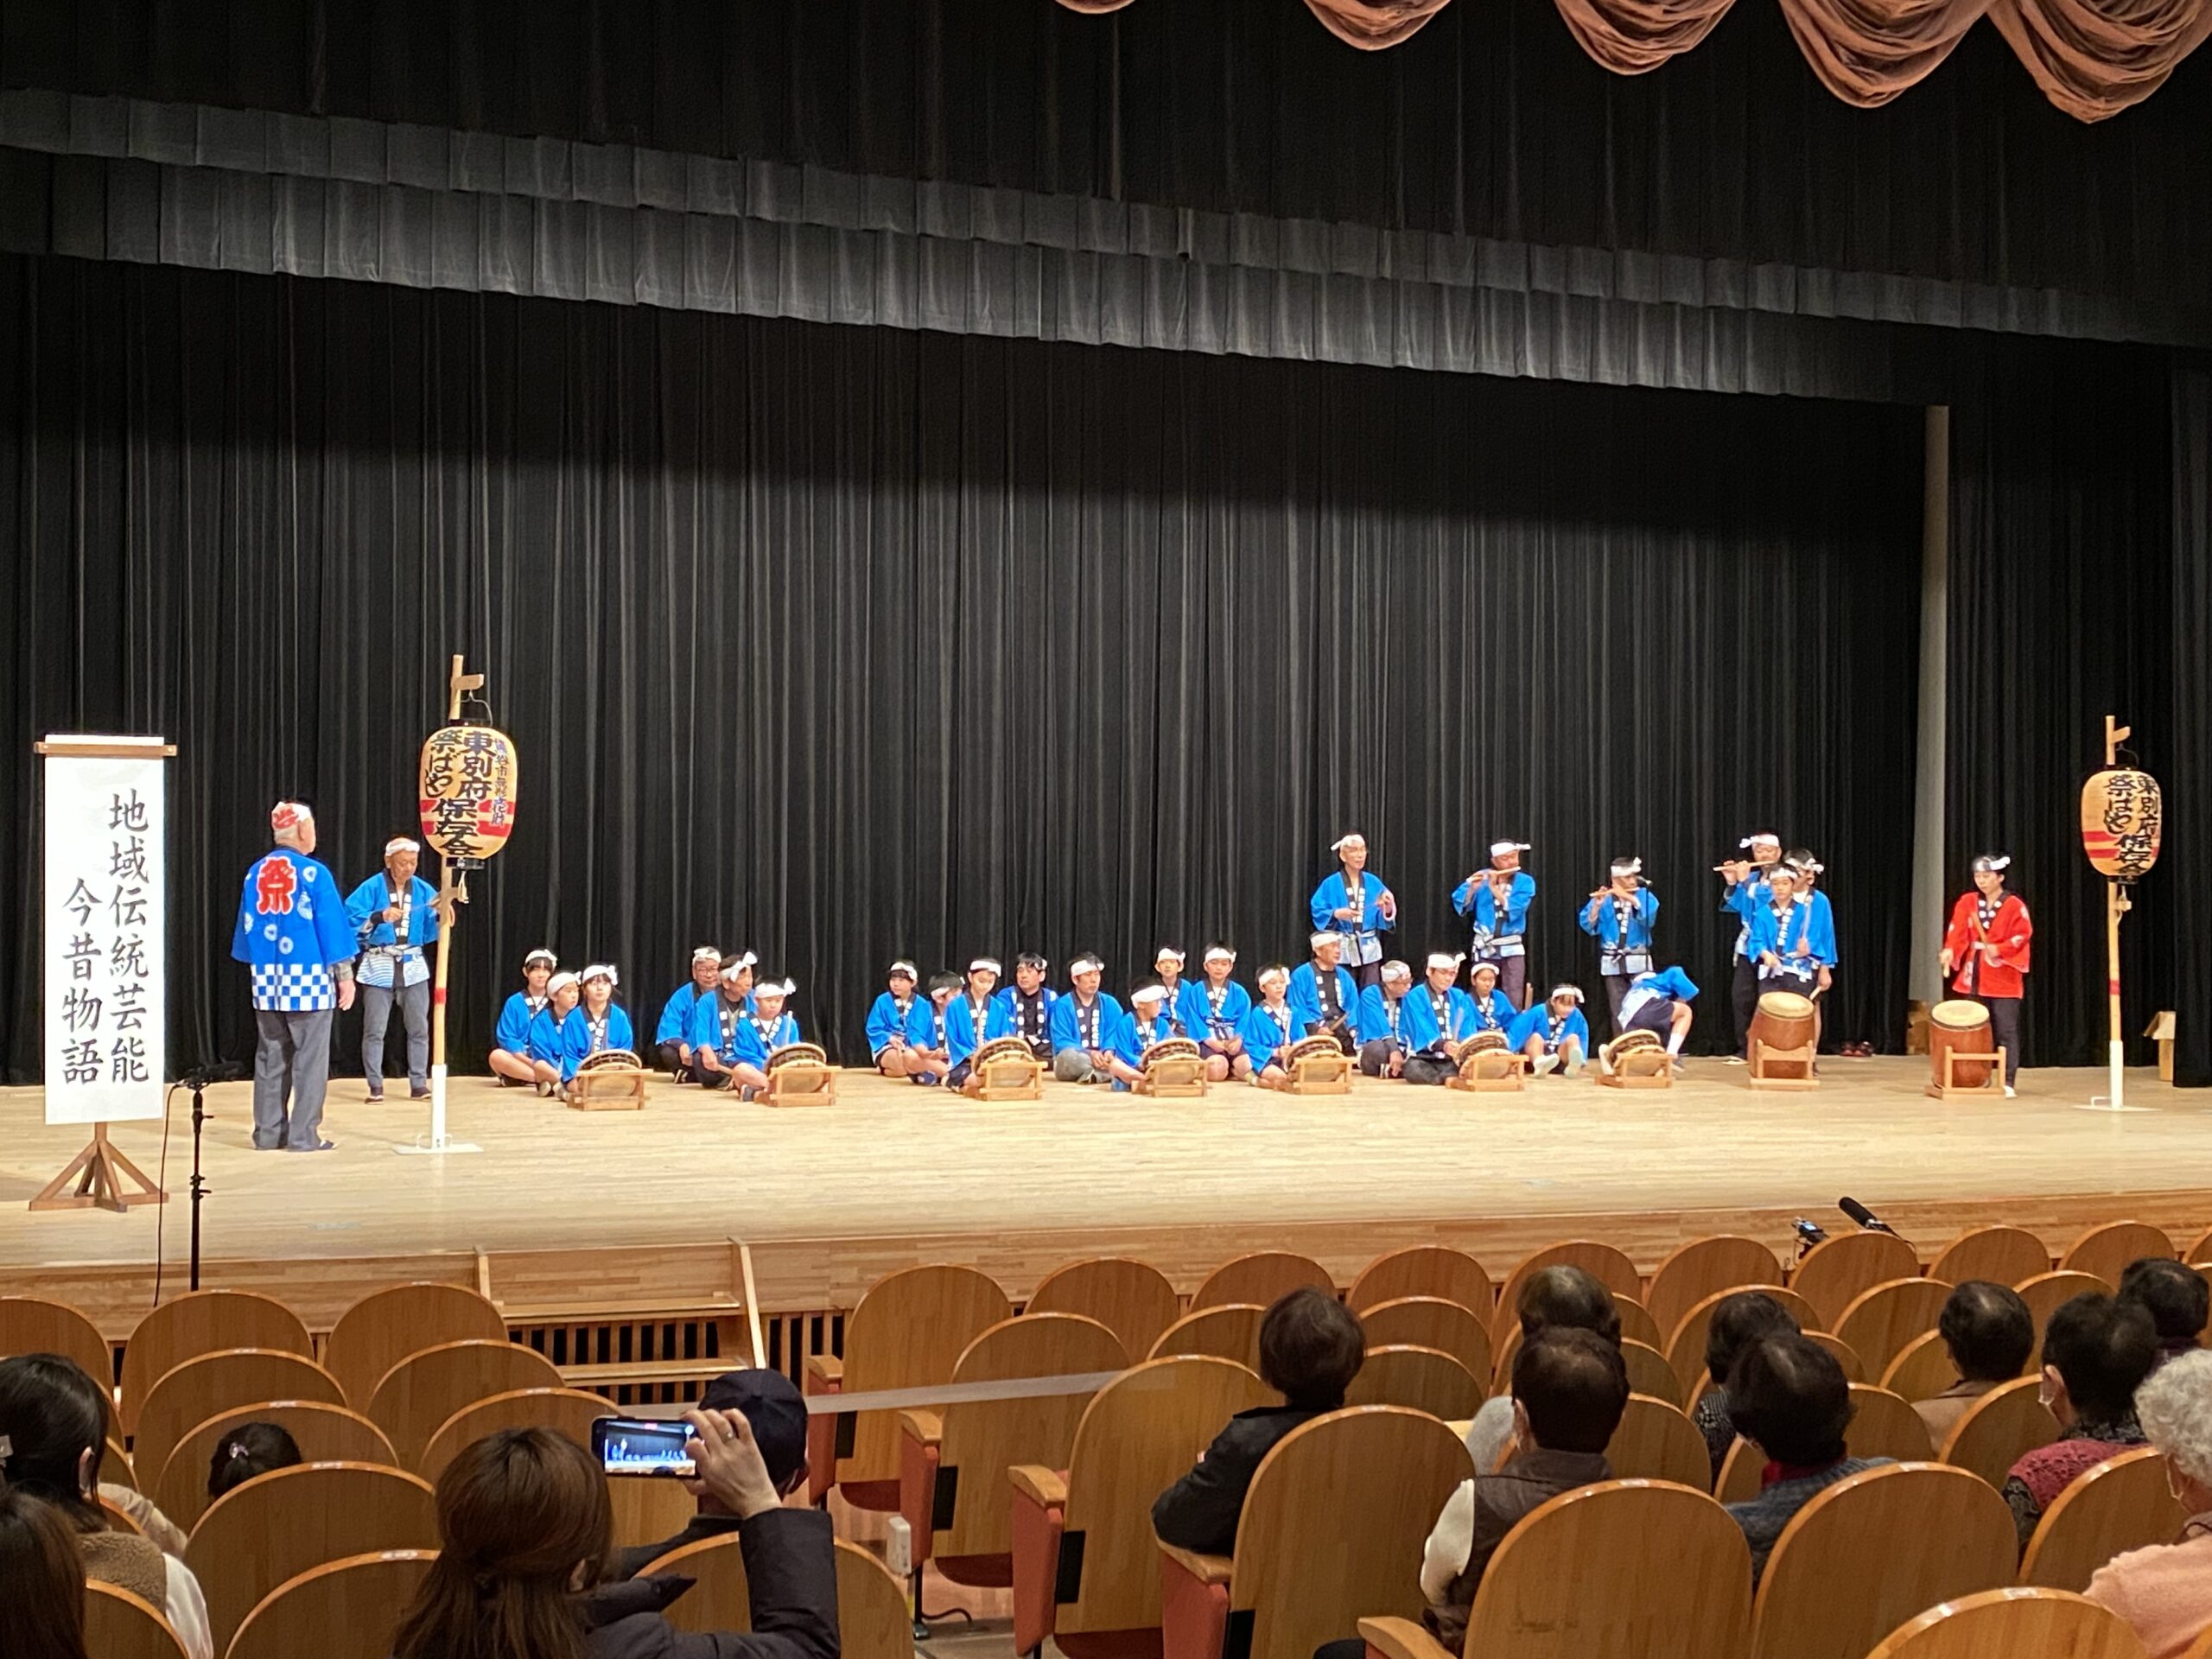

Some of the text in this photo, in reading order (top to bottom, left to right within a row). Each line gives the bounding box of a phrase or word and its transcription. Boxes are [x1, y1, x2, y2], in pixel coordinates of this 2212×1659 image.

[455, 731, 497, 800] 東別府
[432, 798, 484, 856] 保存会
[2137, 775, 2158, 836] 東別府
[257, 857, 296, 914] 祭
[2113, 834, 2152, 876] 保存会
[109, 788, 149, 1084] 地域伝統芸能
[62, 877, 104, 1085] 今昔物語
